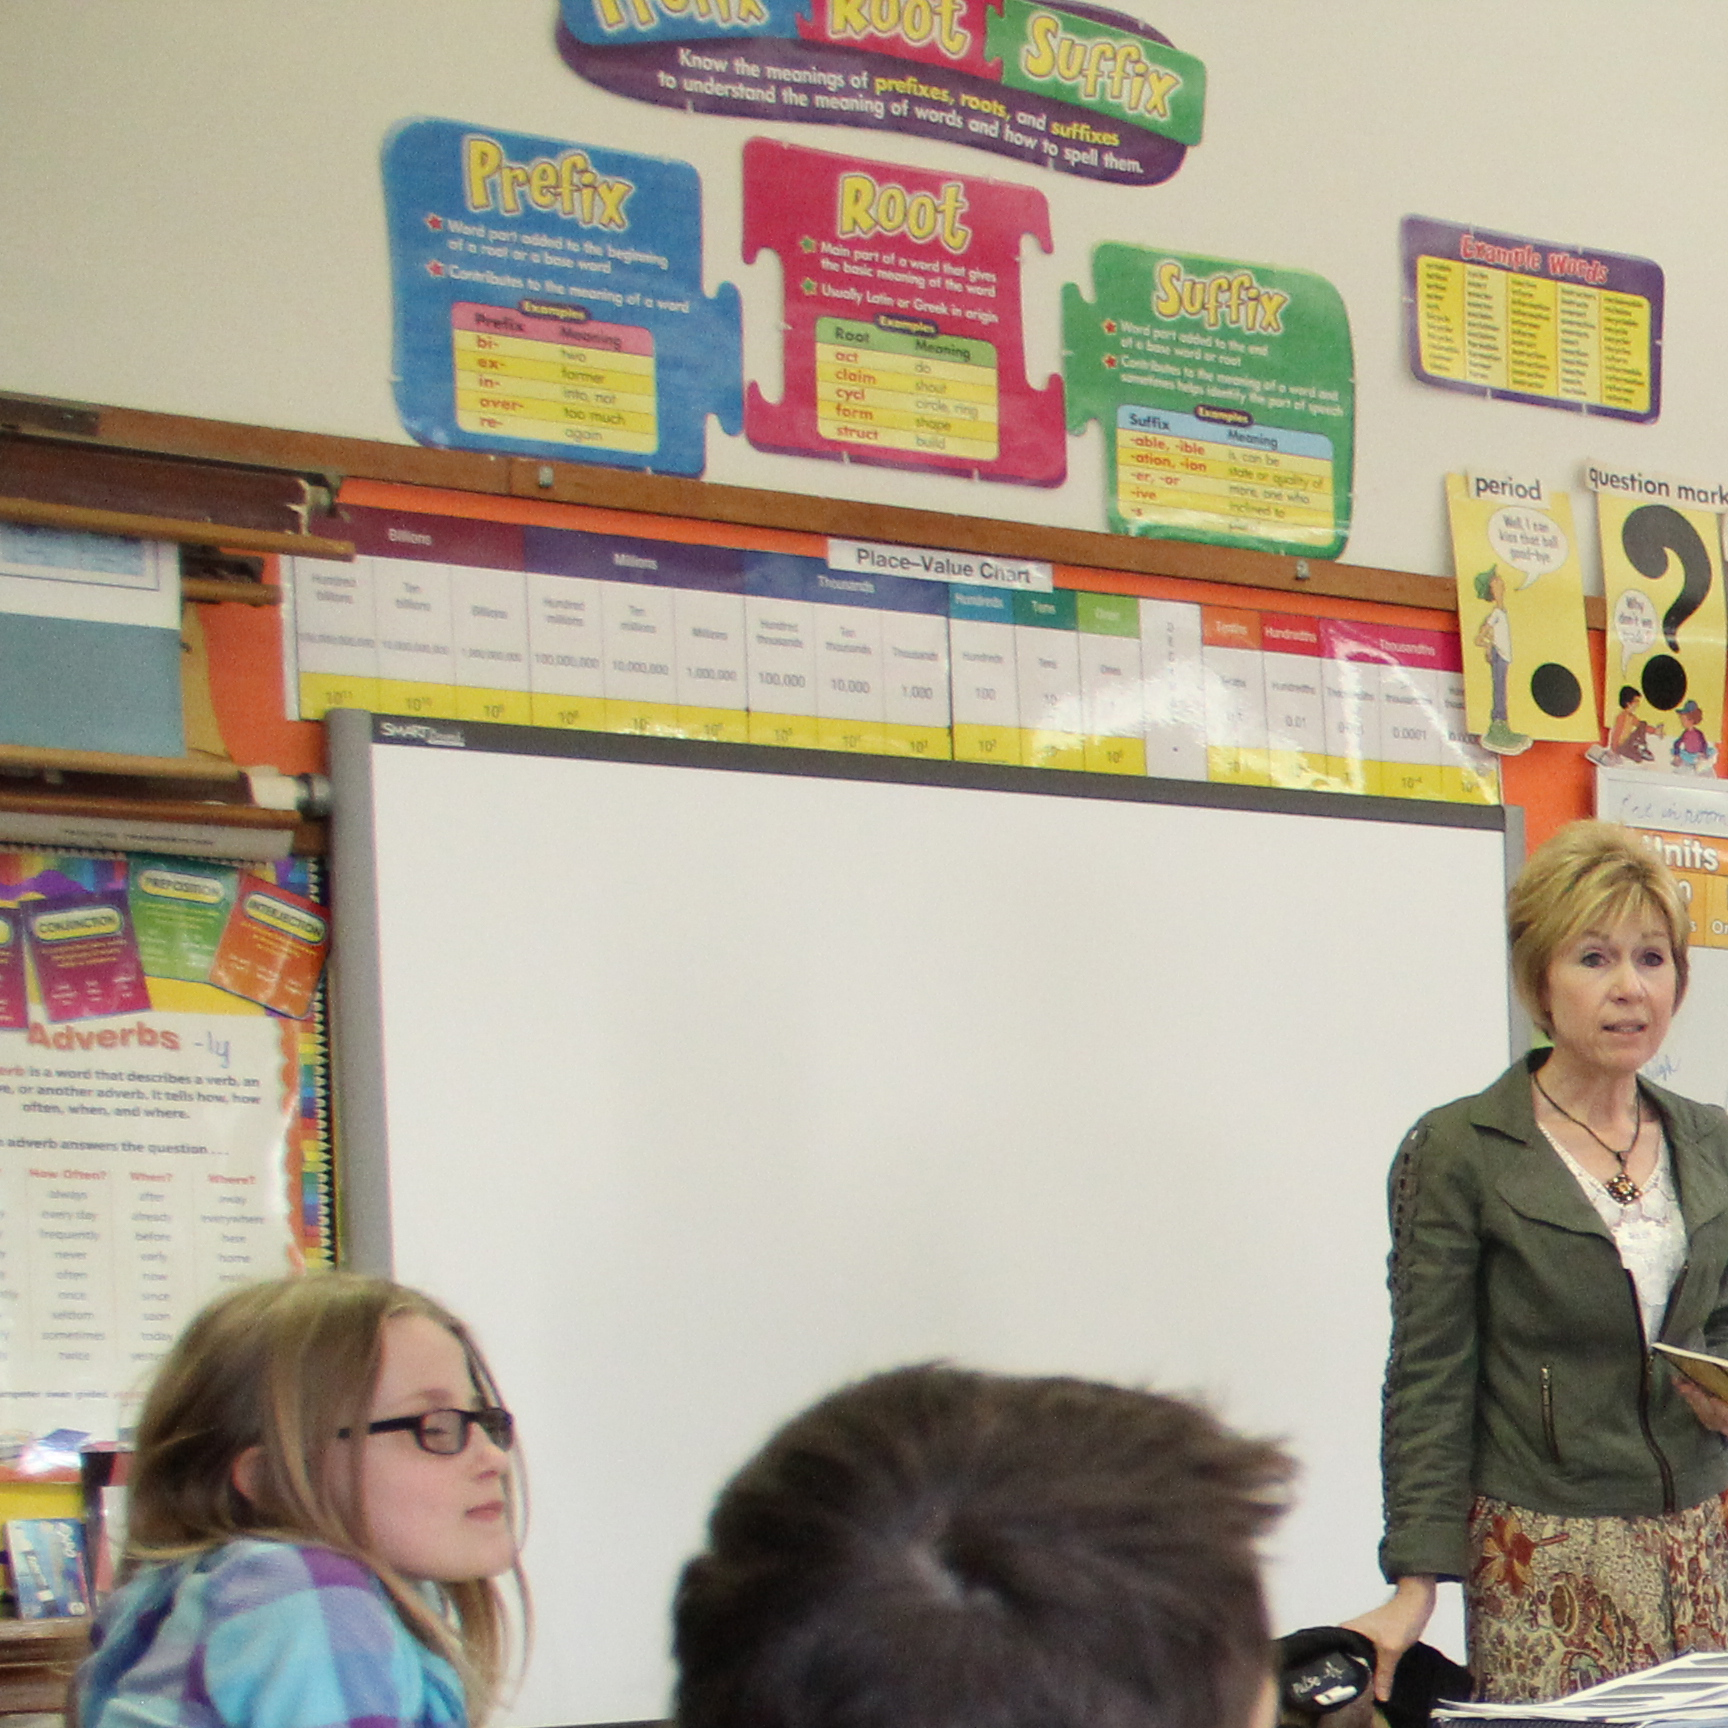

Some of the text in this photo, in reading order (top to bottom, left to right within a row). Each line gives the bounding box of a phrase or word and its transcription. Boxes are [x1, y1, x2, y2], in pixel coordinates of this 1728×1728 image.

[1022, 14, 1183, 118] Suffix
[679, 48, 1120, 148] Know the meanings of prefixes, roots, and suffixes
[657, 69, 1146, 175] to understand the meaning of words and how to spell them.
[465, 136, 635, 232] Prefix
[837, 172, 972, 255] Root
[1459, 233, 1609, 285] Example Words
[1153, 258, 1291, 334] Suffix
[835, 349, 859, 364] act
[835, 368, 877, 385] claim
[835, 386, 866, 402] cycl
[479, 396, 525, 413] over-
[835, 404, 875, 421] form
[836, 425, 879, 441] struct
[1129, 411, 1278, 451] Suffix Meaning
[1475, 474, 1542, 504] period
[1587, 464, 1671, 501] question
[855, 546, 1032, 586] Place-Value Chart
[27, 1021, 181, 1052] Adverbs
